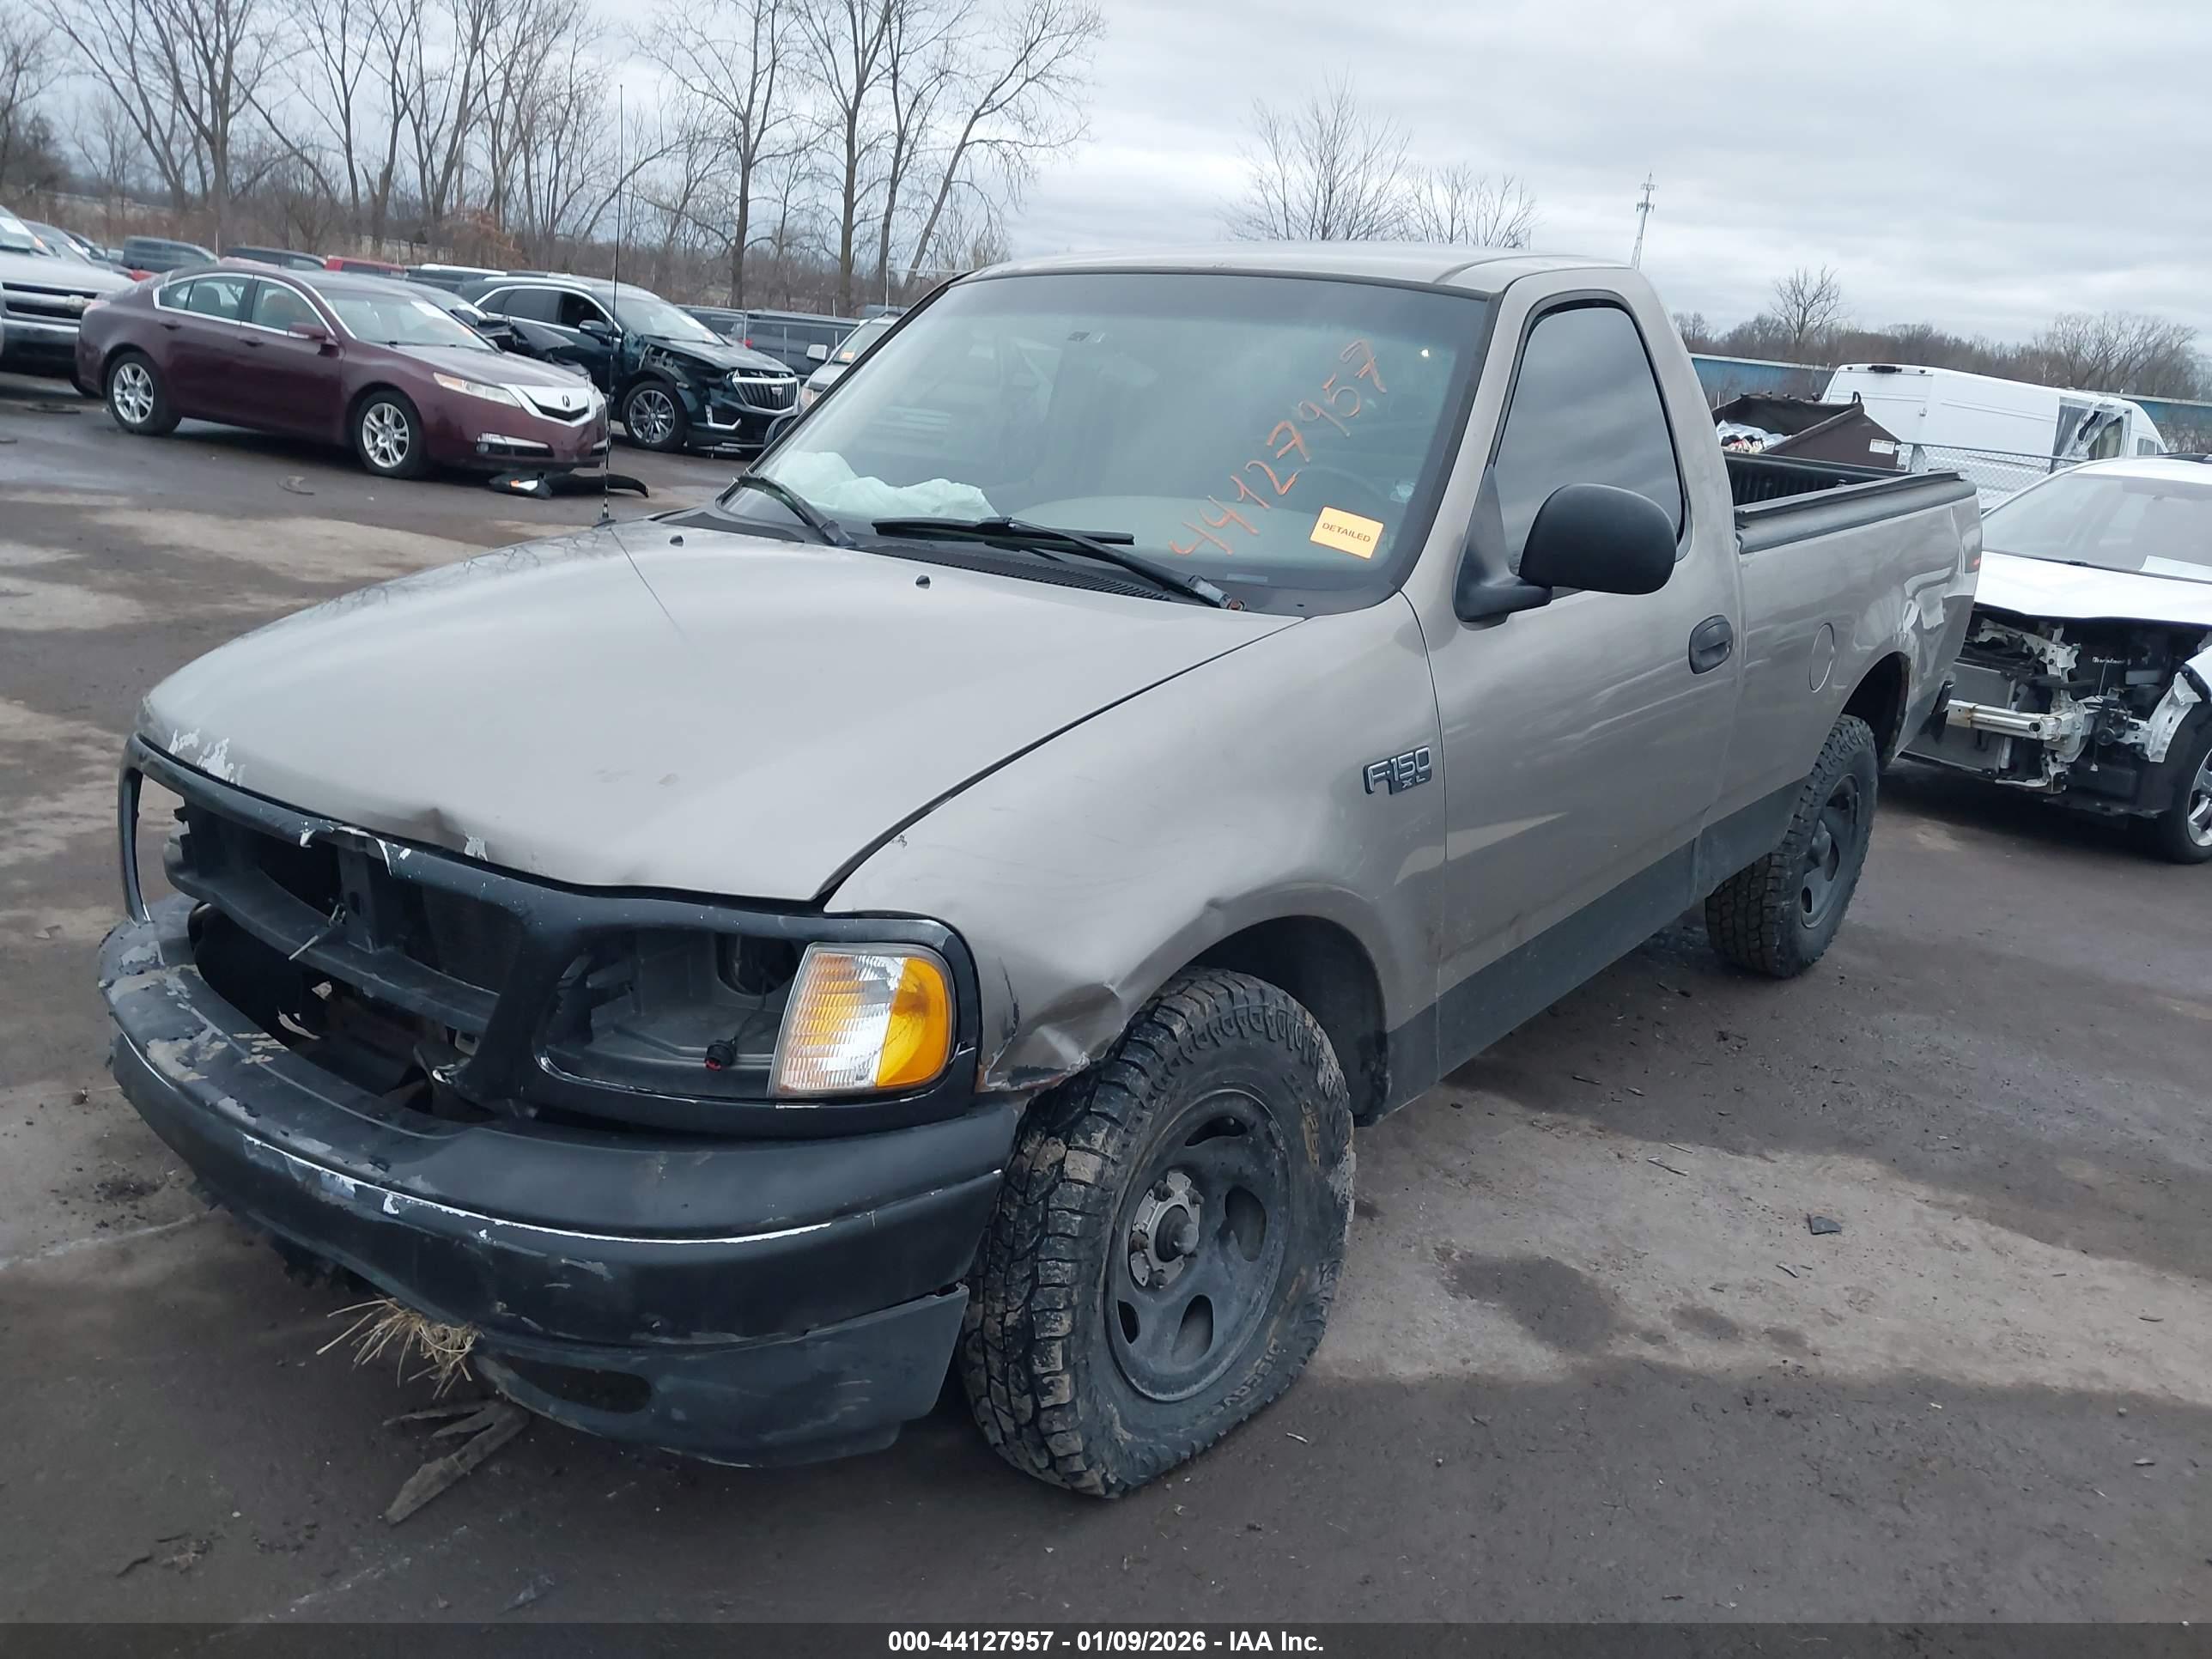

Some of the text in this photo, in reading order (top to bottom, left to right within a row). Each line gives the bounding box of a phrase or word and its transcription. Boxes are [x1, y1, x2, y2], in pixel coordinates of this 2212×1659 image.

[1168, 338, 1388, 556] 44127957
[1322, 522, 1371, 543] DETAILED
[1367, 746, 1431, 793] F-150
[1401, 775, 1426, 788] XL
